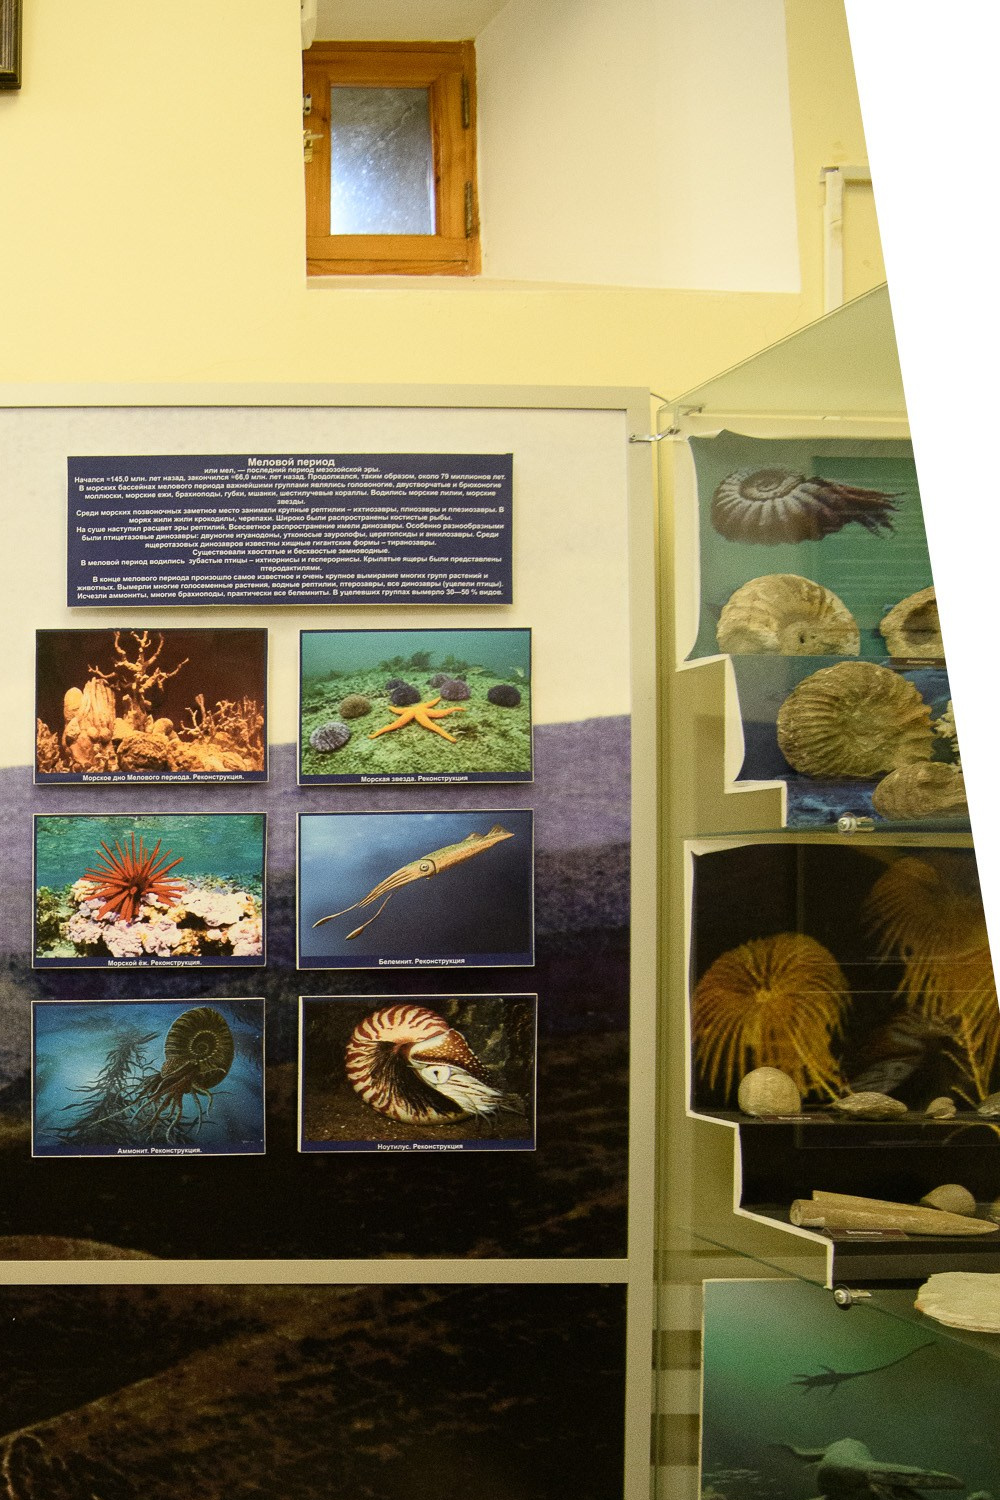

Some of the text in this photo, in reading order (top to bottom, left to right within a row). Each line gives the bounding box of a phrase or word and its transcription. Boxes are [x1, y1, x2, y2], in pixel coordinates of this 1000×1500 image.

[248, 458, 294, 466] Меловой
[192, 773, 244, 781] Реконструкция.
[360, 775, 390, 783] Морская
[417, 774, 468, 782] Реконструкция
[414, 957, 465, 965] Реконструкция
